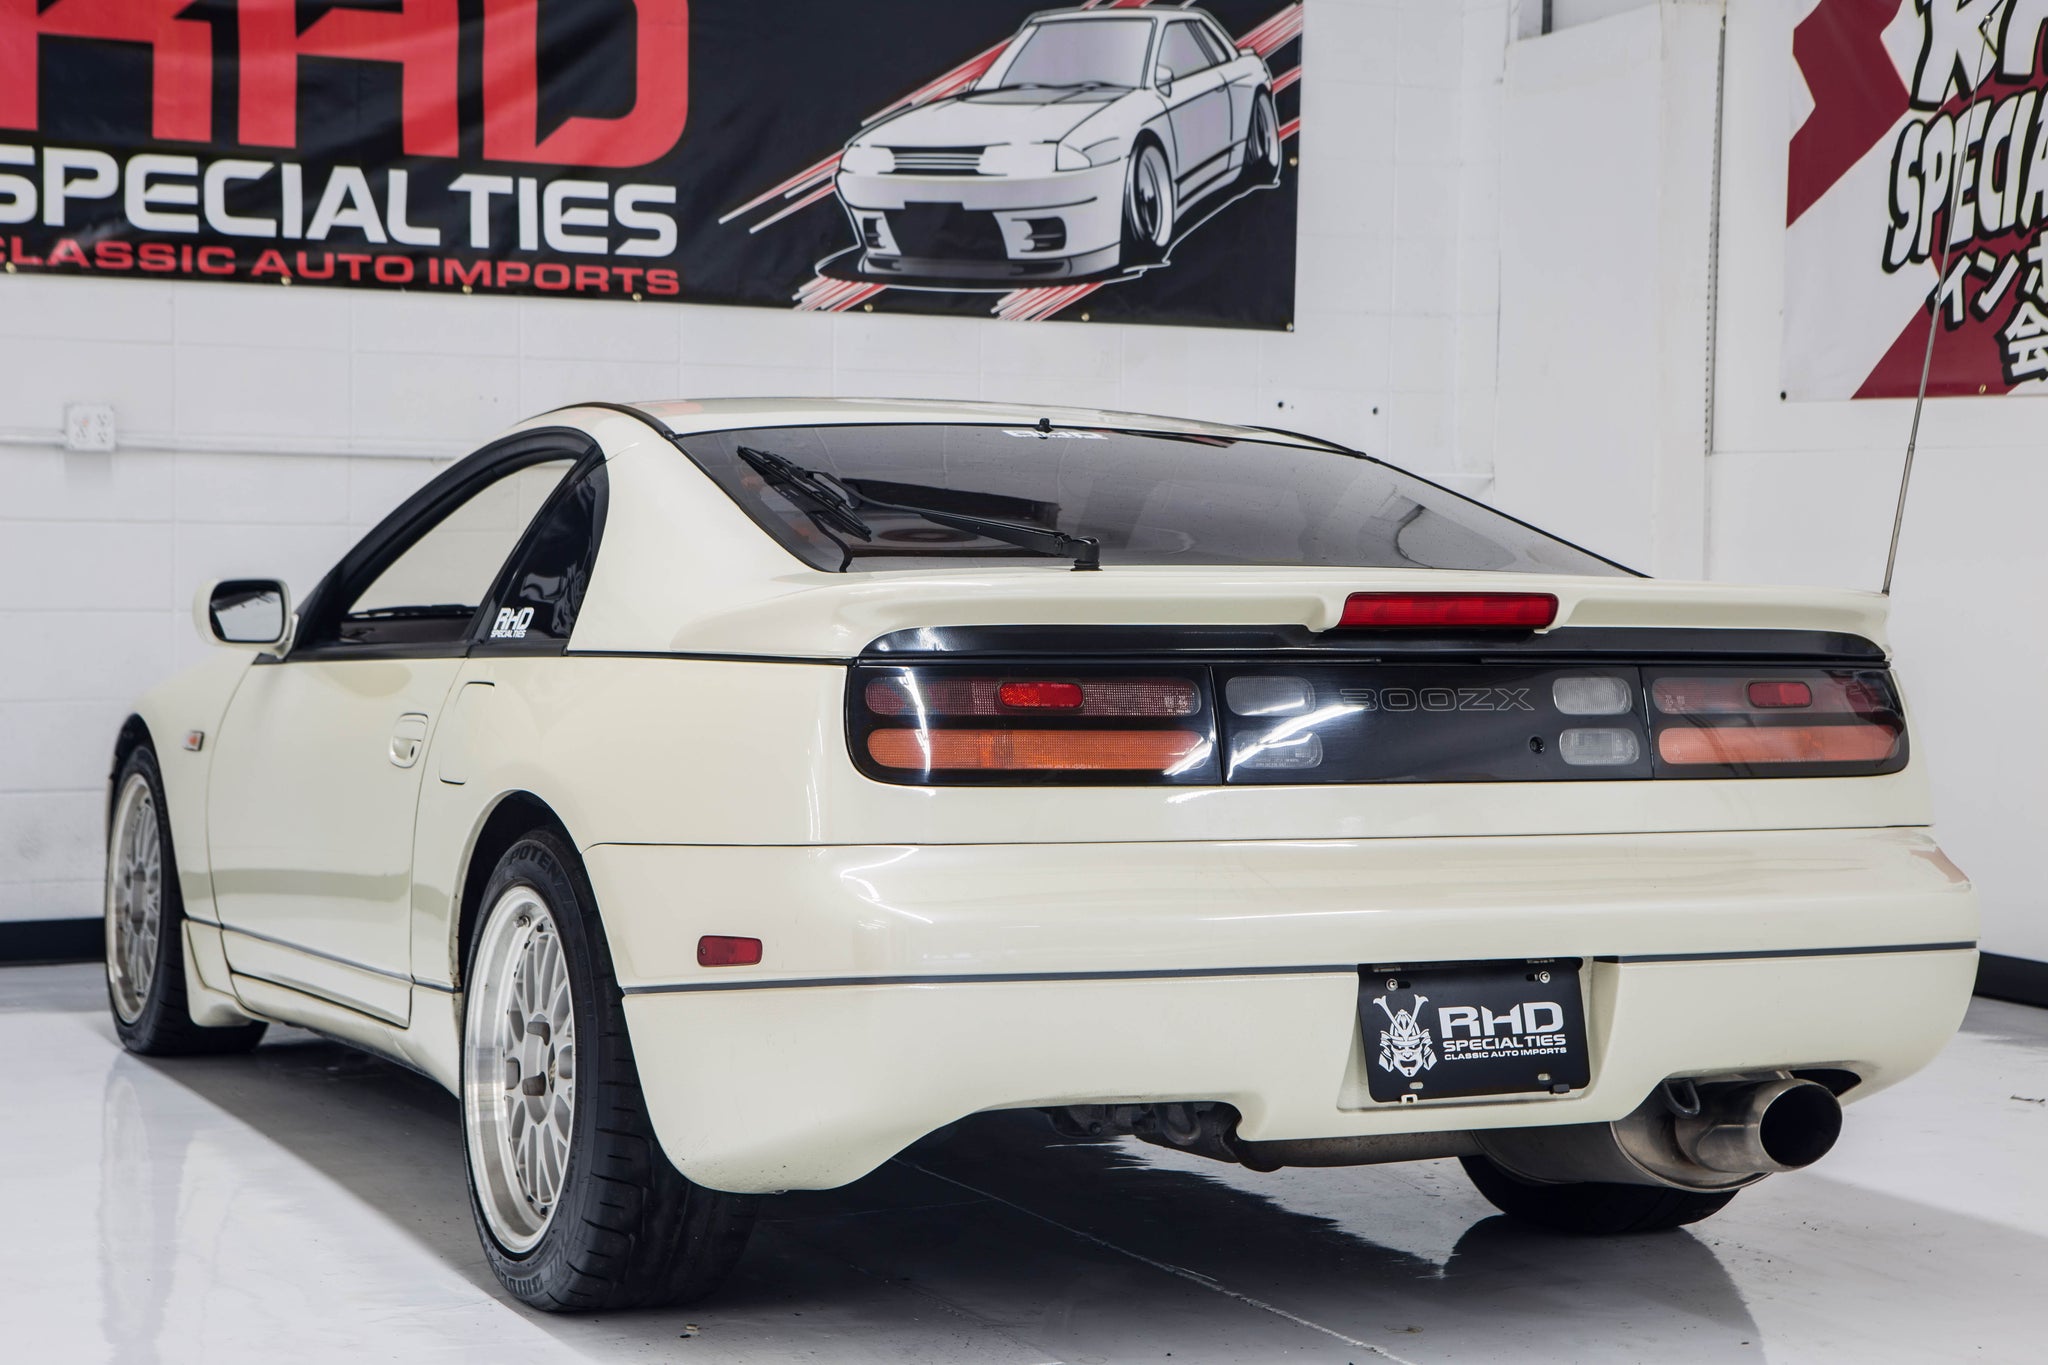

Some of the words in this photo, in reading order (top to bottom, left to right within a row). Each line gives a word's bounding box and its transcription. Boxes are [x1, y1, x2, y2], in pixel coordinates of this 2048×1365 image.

[0, 236, 236, 275] LASSIC
[251, 248, 413, 284] AUTO
[429, 257, 680, 295] IMPORTS
[493, 607, 535, 630] RHD
[1339, 688, 1535, 711] 300ZX
[1438, 1001, 1564, 1039] RHD
[1442, 1034, 1566, 1052] SPECIALTIES
[1444, 1051, 1489, 1061] CLASSIC
[1491, 1050, 1519, 1058] AUTO
[1520, 1046, 1567, 1056] IMPORTS
